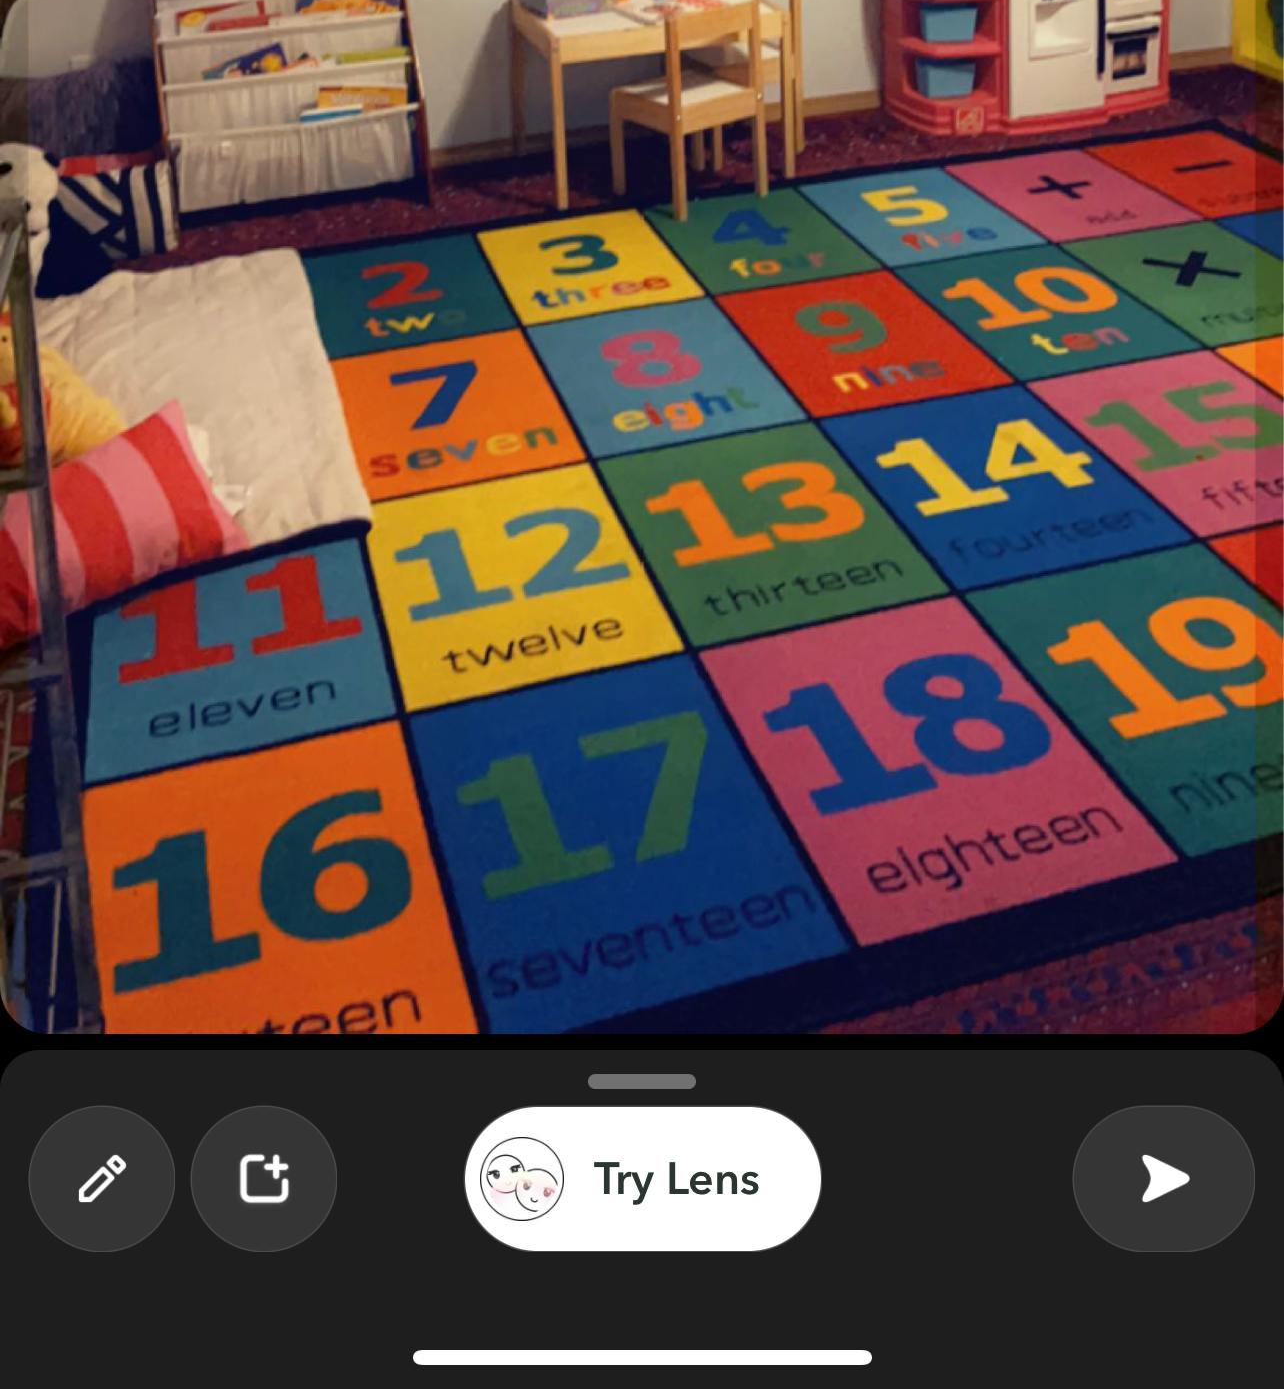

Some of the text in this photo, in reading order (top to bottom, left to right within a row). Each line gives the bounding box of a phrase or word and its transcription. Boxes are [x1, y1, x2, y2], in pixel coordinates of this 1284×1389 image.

[712, 208, 792, 246] 4
[860, 186, 949, 226] 5
[537, 234, 620, 276] 3
[360, 261, 445, 309] 2
[531, 275, 670, 309] three
[942, 265, 1119, 331] 10
[364, 310, 466, 337] two
[794, 300, 888, 353] 9
[1031, 327, 1131, 355] ten
[600, 330, 703, 389] 8
[832, 361, 945, 393] nine
[389, 360, 478, 431] 7
[612, 387, 759, 432] eight
[368, 426, 559, 479] seven
[1085, 381, 1283, 472] 15
[876, 418, 1095, 517] 14
[645, 462, 865, 568] 13
[950, 509, 1153, 563] fourteen
[395, 507, 632, 622] 12
[703, 557, 903, 617] thirteen
[119, 555, 363, 685] 11
[441, 618, 622, 674] twelve
[1047, 595, 1283, 740] 19
[149, 679, 337, 738] eleven
[763, 652, 1052, 817] 18
[455, 710, 708, 901] 17
[867, 805, 1122, 895] eighteen
[112, 788, 413, 995] 16
[487, 885, 815, 999] seventeen
